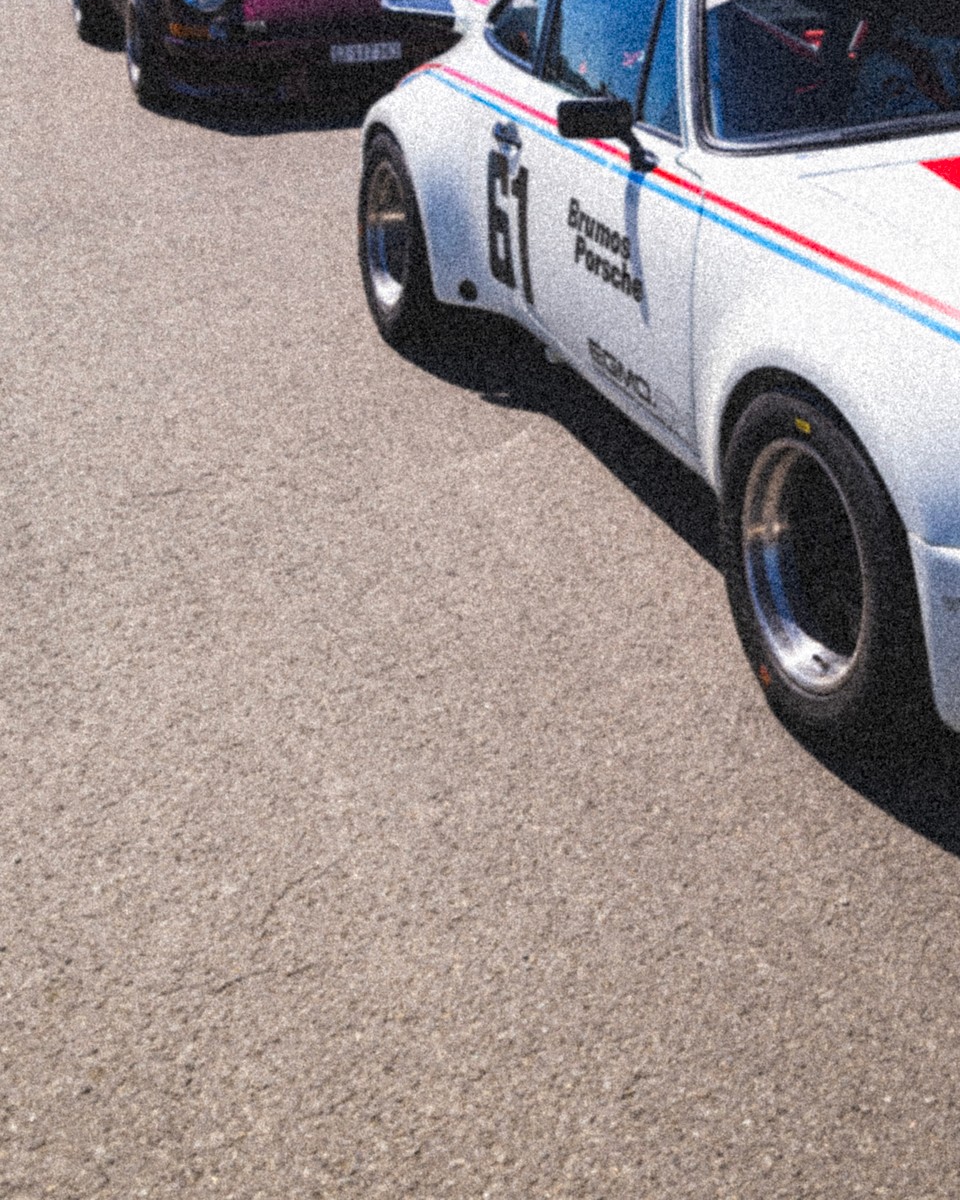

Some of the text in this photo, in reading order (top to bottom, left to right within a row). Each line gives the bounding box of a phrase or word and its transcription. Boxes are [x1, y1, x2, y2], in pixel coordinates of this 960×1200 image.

[487, 149, 535, 306] 61
[567, 197, 632, 261] Brumos
[574, 234, 644, 304] Porsche
